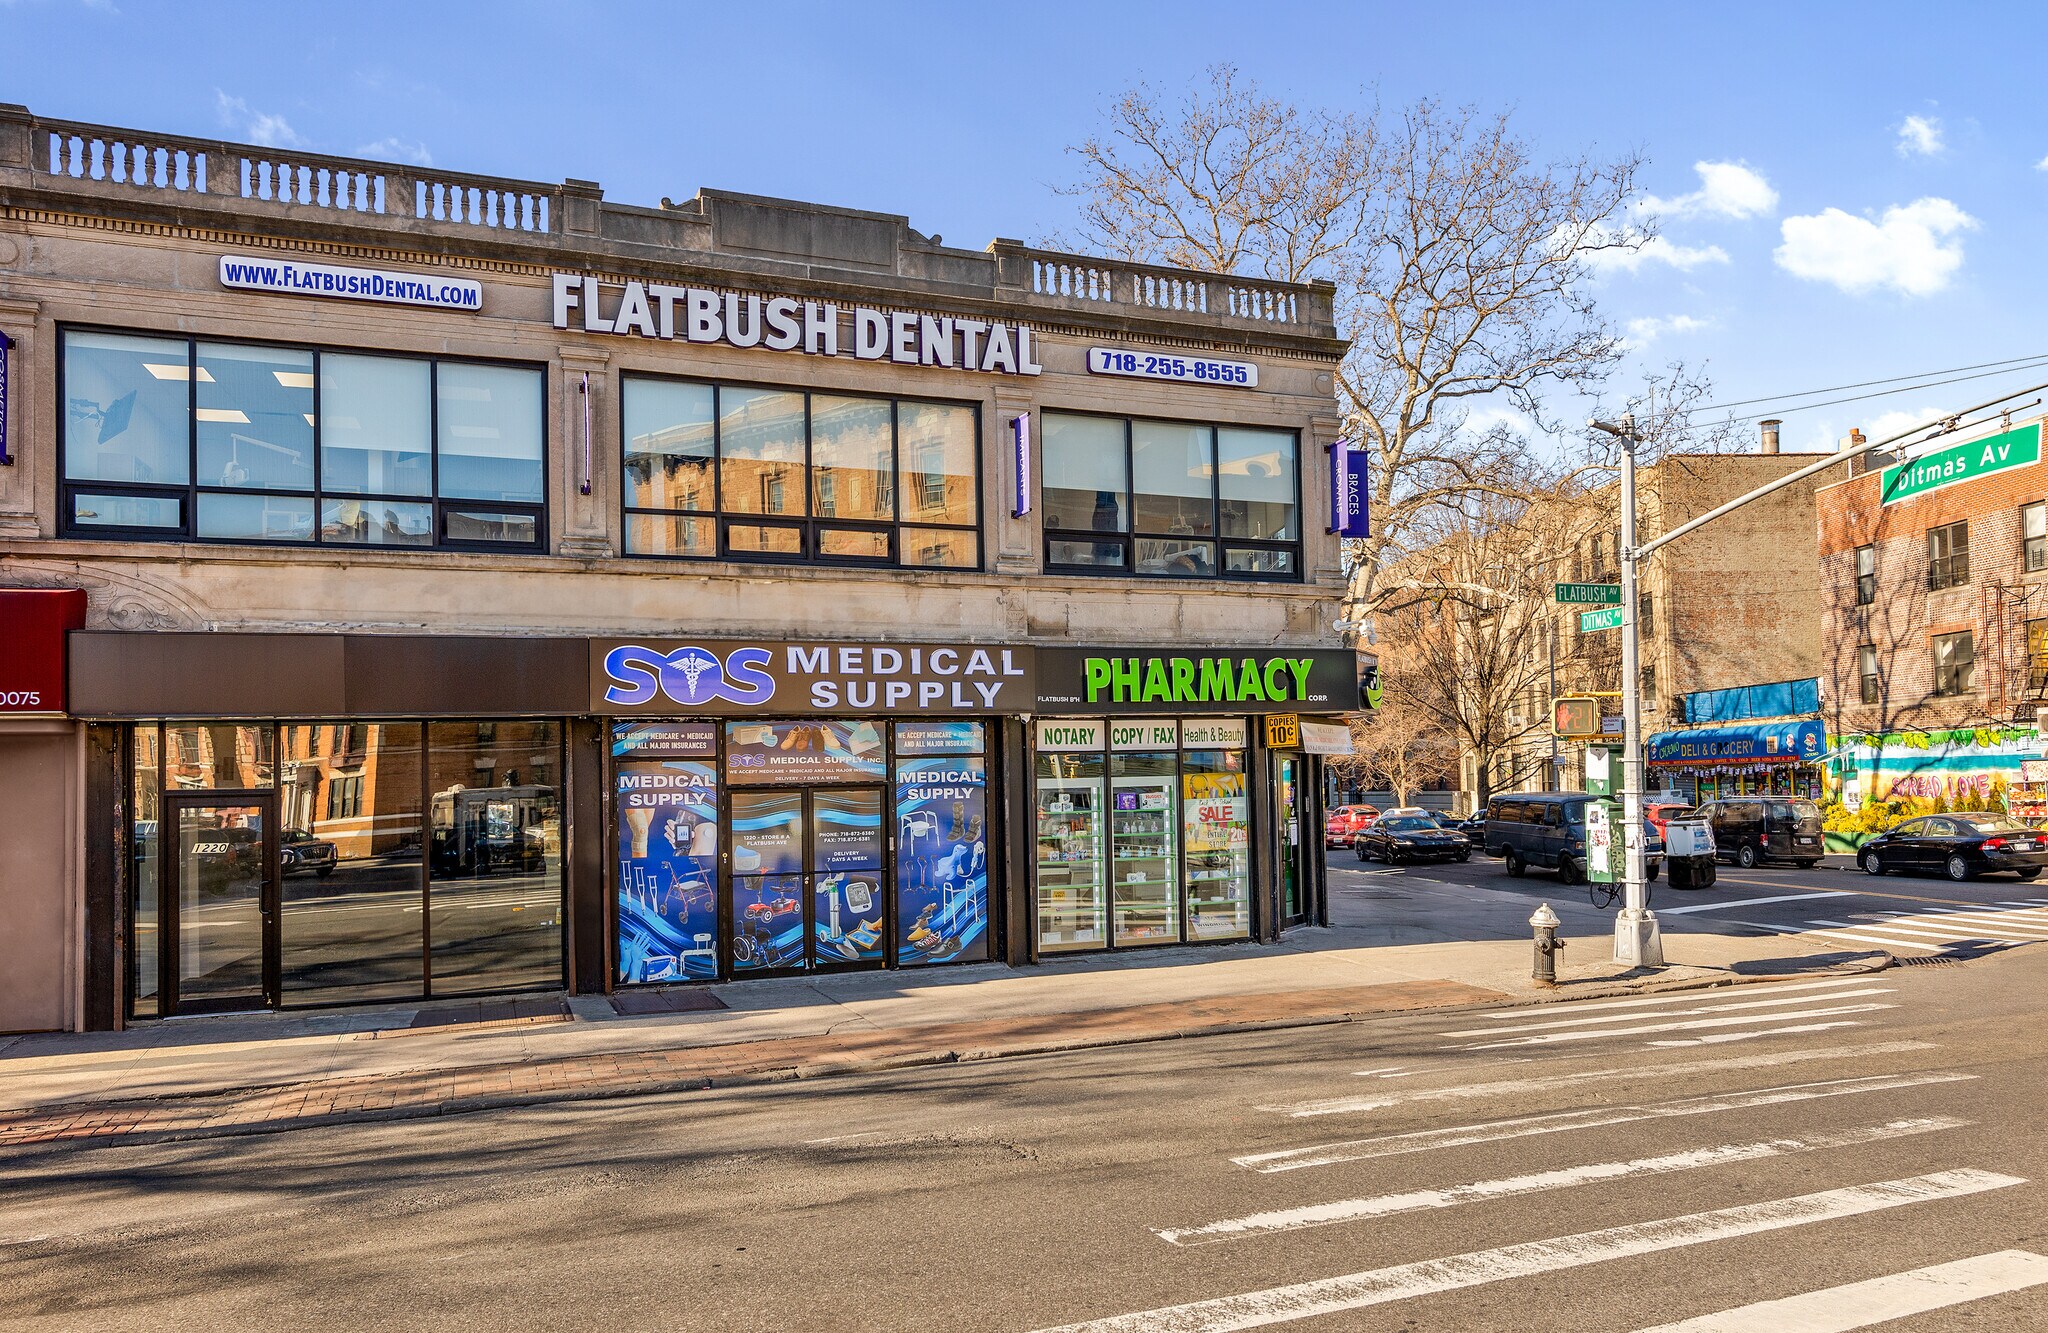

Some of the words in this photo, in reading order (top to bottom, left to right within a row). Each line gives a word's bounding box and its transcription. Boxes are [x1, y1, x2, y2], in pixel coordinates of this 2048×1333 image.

[552, 273, 837, 356] FLATBUSH
[855, 307, 1043, 376] DENTAL
[1101, 352, 1248, 383] 718-255-8555
[1898, 456, 1966, 492] Ditmas
[1980, 443, 2011, 467] Av
[1335, 459, 1343, 513] CROWNS
[1348, 473, 1359, 515] BRACES
[1558, 586, 1607, 602] FLATBUSH
[1609, 587, 1618, 595] AV
[1583, 611, 1613, 630] DITMAS
[786, 646, 1025, 676] MEDICAL
[604, 645, 776, 705] SOS
[1085, 658, 1314, 703] PHARMACY
[811, 681, 1004, 708] SUPPLY
[1037, 695, 1069, 703] FLATBUSH
[1268, 716, 1295, 727] COPIES
[650, 732, 679, 740] MEDICARE
[686, 732, 714, 740] MEDICAID
[1044, 727, 1096, 745] NOTARY
[1112, 727, 1144, 745] COPY
[1153, 727, 1175, 744] FAX
[1184, 727, 1208, 743] Health
[1210, 728, 1216, 742] &
[1218, 727, 1245, 744] Beauty
[1681, 743, 1700, 757] DELI
[1702, 743, 1708, 756] &
[1710, 740, 1755, 756] GROCERY
[729, 754, 766, 767] SOS
[770, 756, 821, 764] MEDICAL
[824, 756, 864, 764] SUPPLY
[620, 775, 715, 788] MEDICAL
[900, 771, 981, 783] MEDICAL
[1891, 774, 1942, 798] SPREAD
[1947, 773, 1990, 798] LOVE
[629, 792, 707, 806] SUPPLY
[907, 787, 975, 800] SUPPLY
[1199, 805, 1233, 822] SALE
[195, 843, 227, 853] 1220
